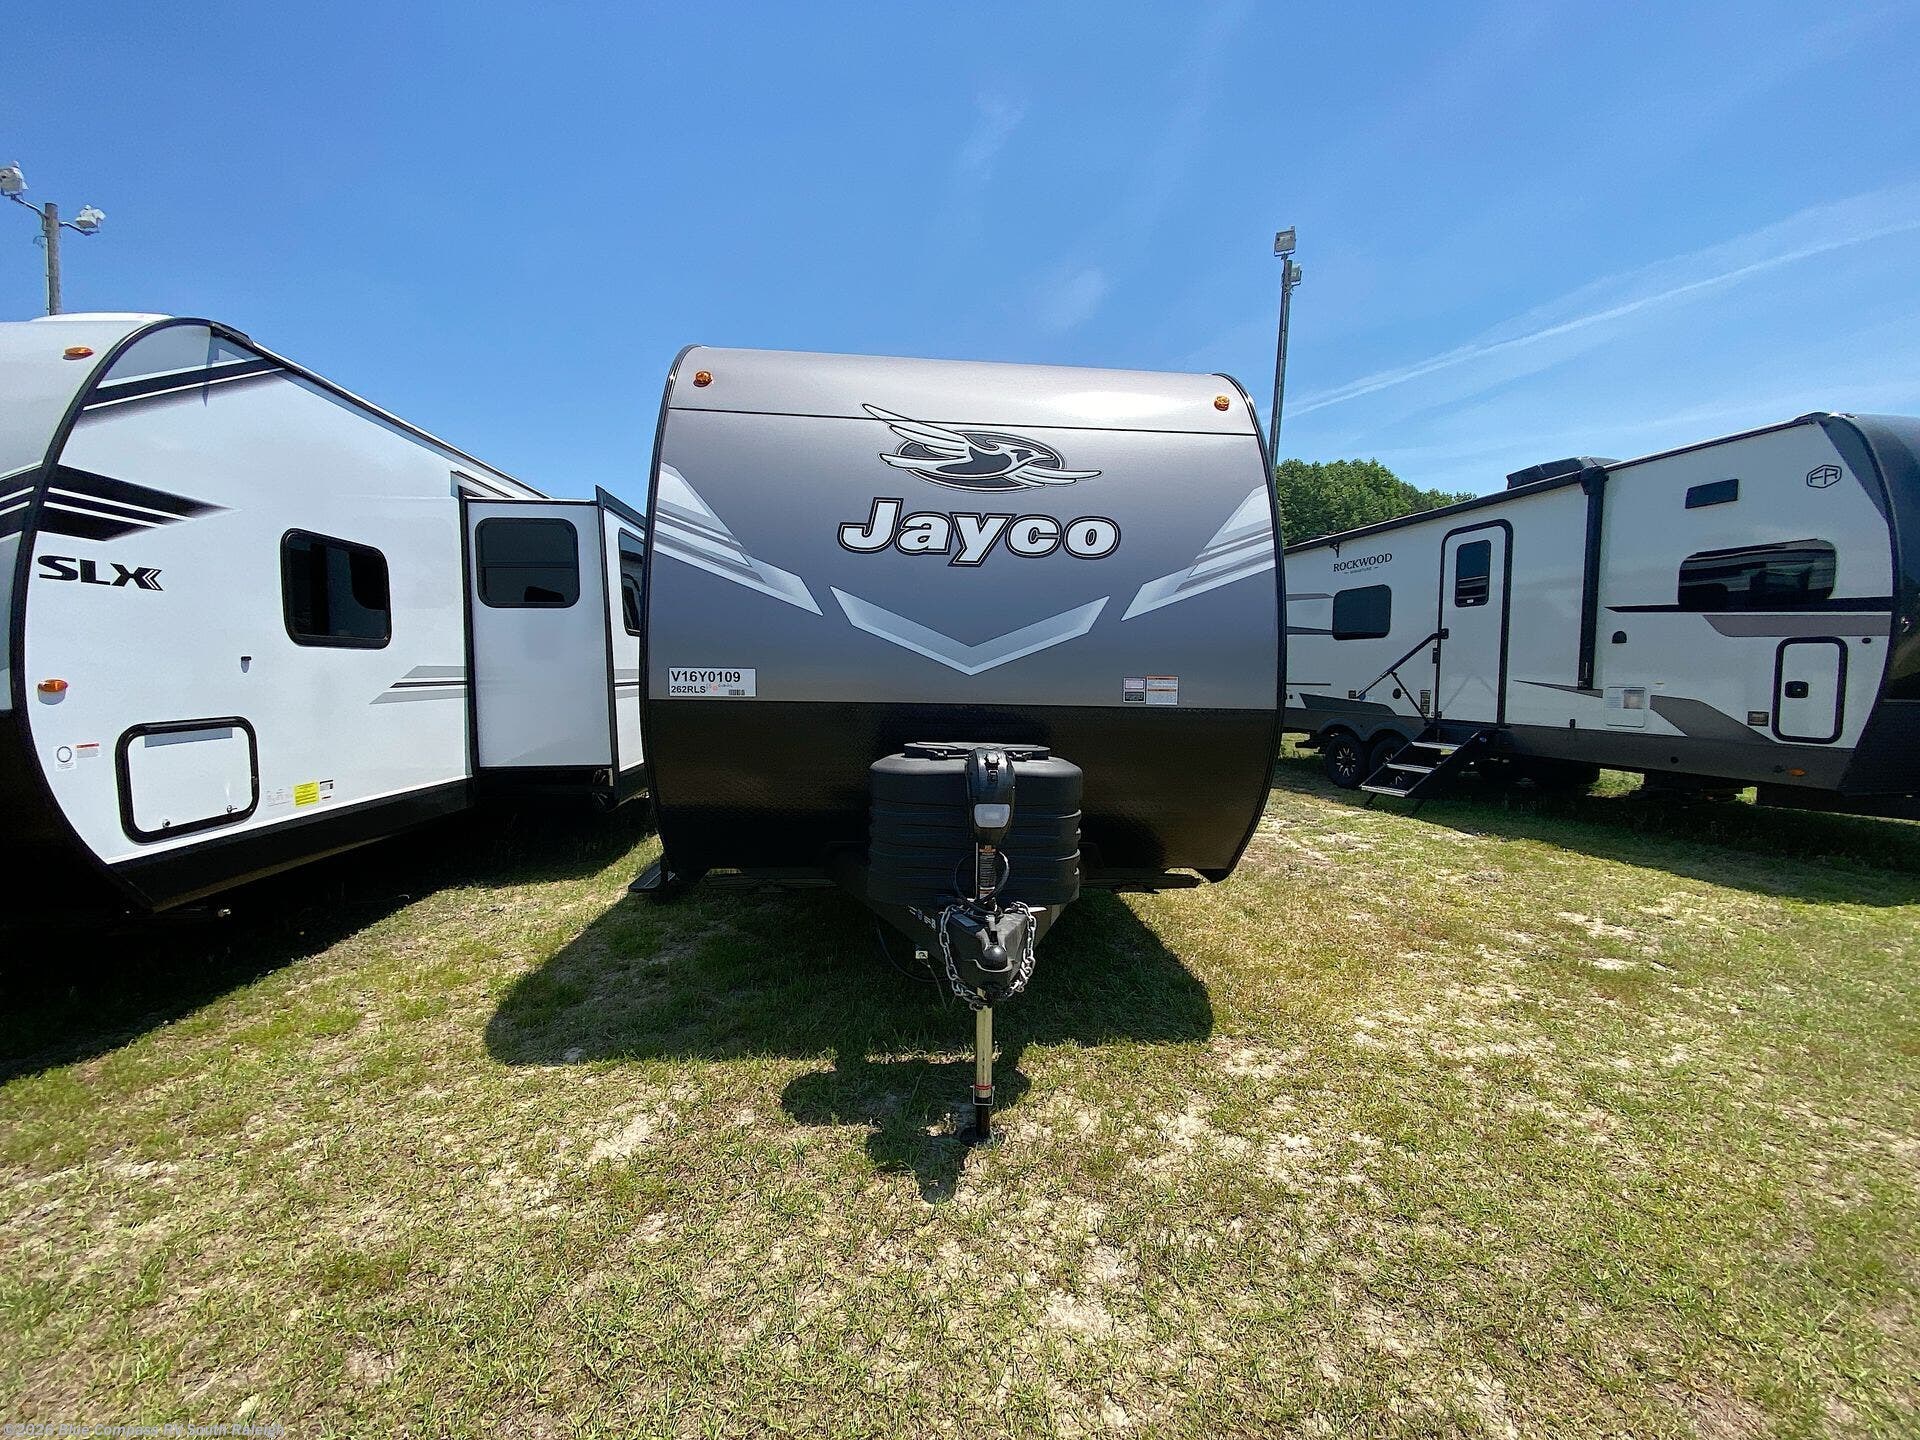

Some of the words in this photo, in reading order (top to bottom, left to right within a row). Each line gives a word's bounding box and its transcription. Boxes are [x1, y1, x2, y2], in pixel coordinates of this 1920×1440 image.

[837, 497, 1122, 567] Jayco
[1333, 553, 1393, 572] ROCKWOOD
[37, 555, 163, 591] SLX
[671, 670, 741, 683] V16Y0109
[671, 685, 706, 694] 262RLS
